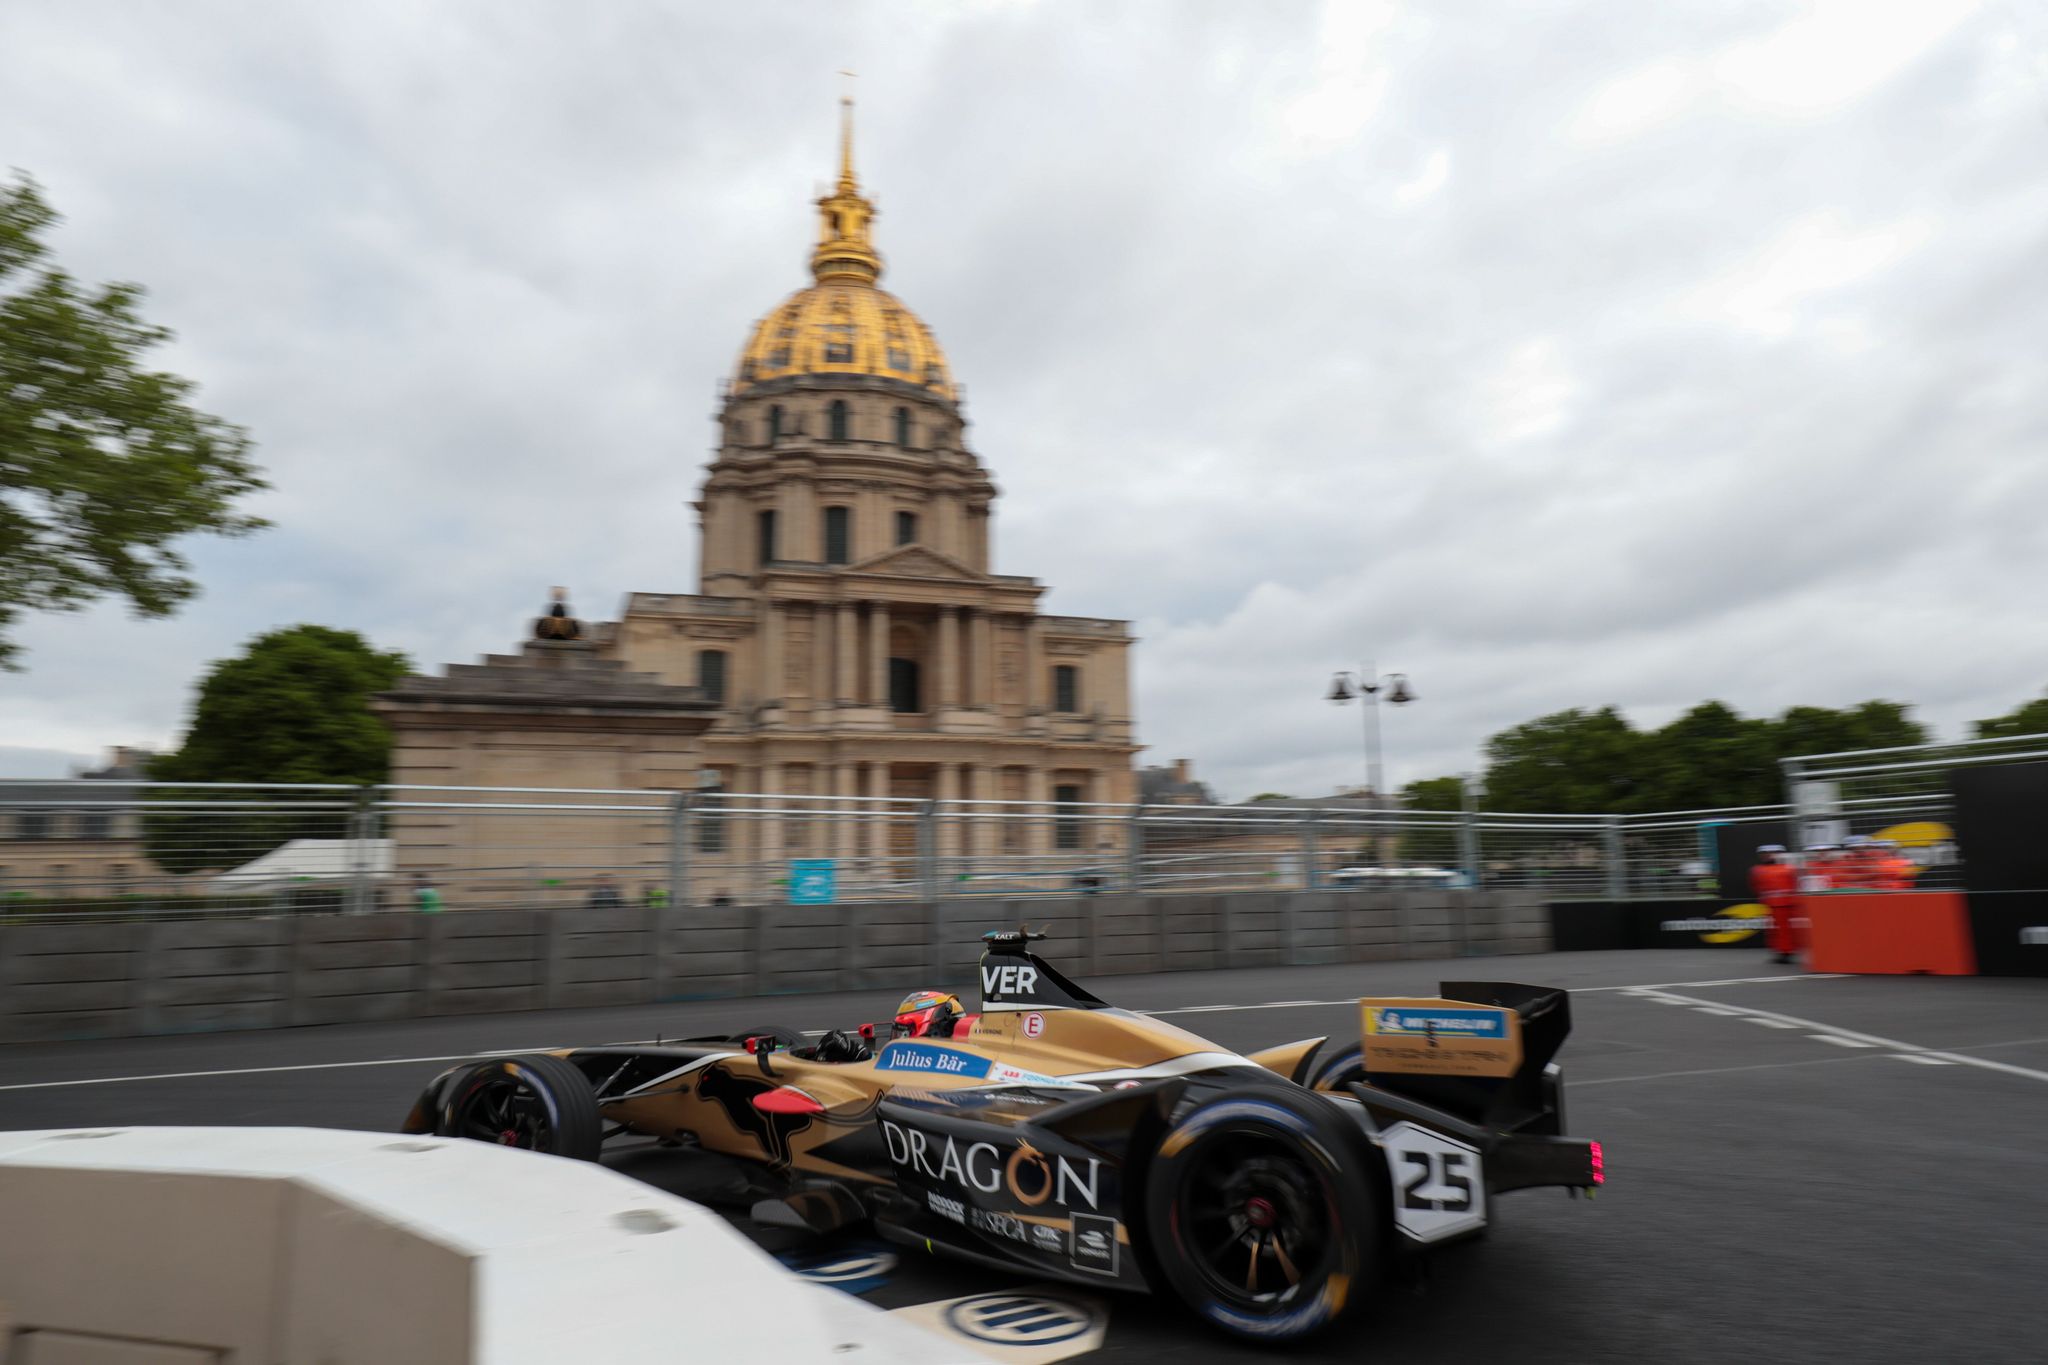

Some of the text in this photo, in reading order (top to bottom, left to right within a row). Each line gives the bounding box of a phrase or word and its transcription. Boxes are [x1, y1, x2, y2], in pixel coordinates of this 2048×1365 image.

[982, 965, 1038, 994] VER
[1028, 1016, 1038, 1034] E
[889, 1049, 968, 1072] Julius Bär
[882, 1120, 1102, 1210] DRAGON
[1401, 1150, 1471, 1212] 25
